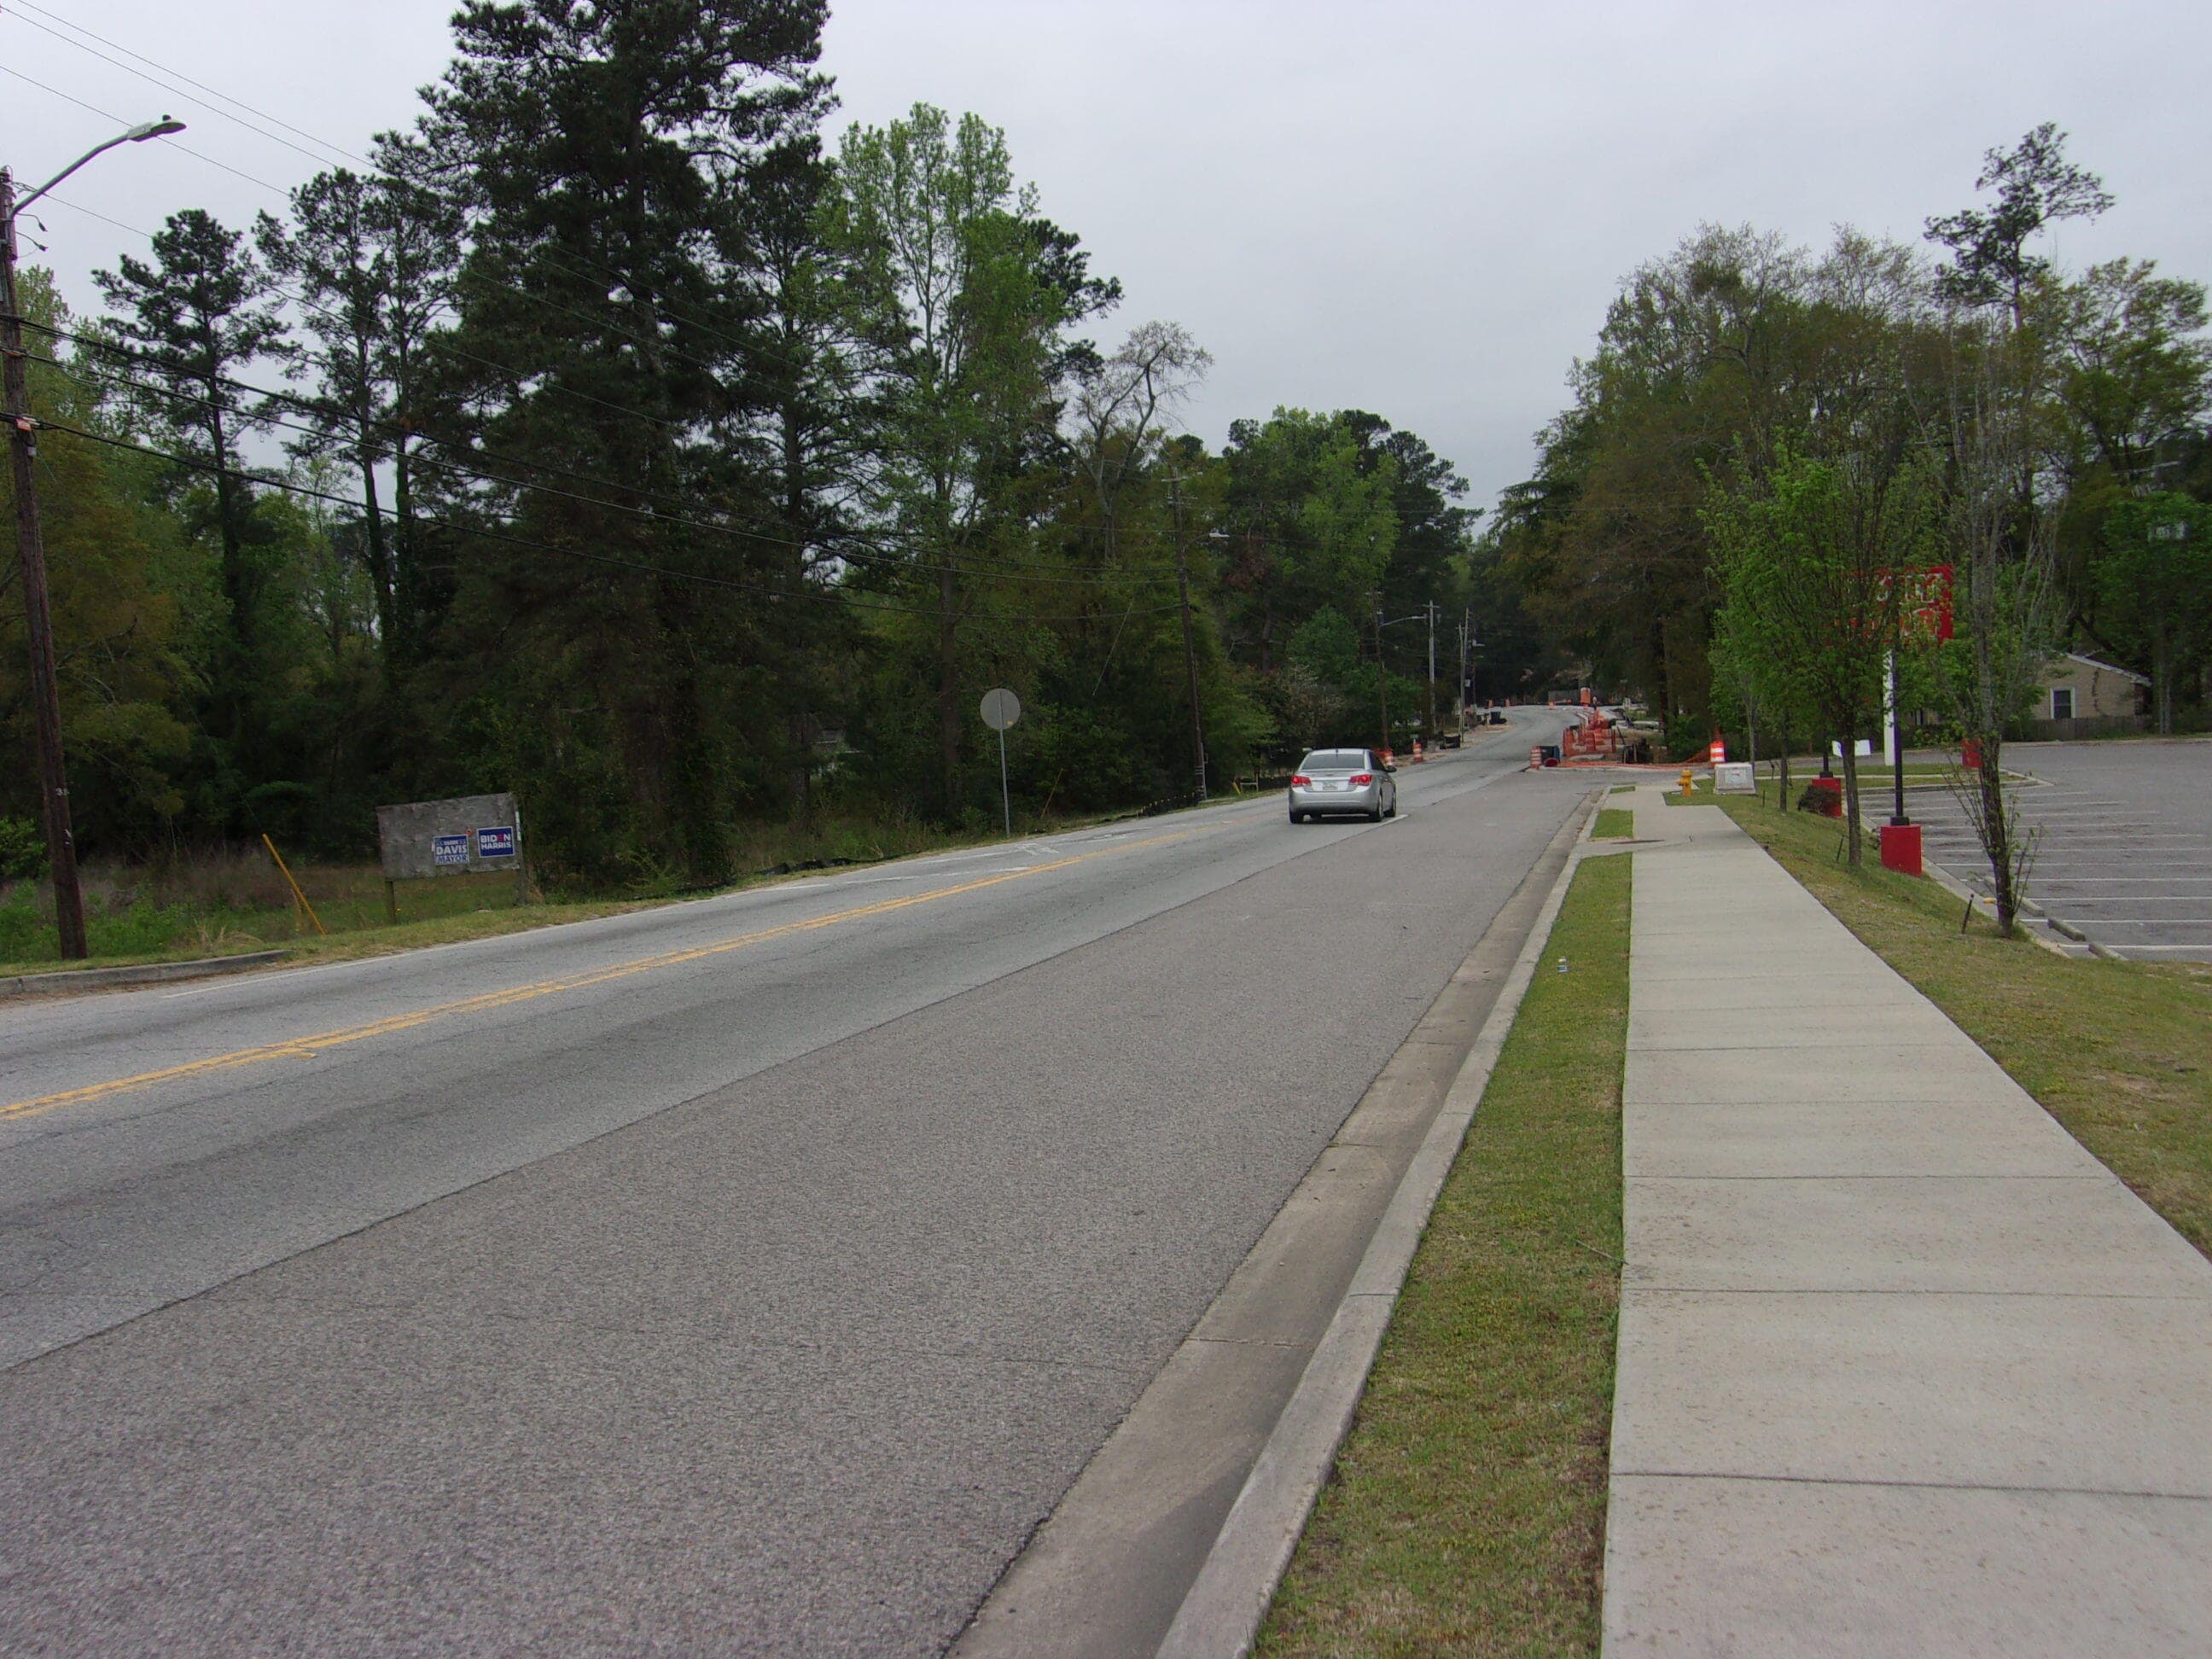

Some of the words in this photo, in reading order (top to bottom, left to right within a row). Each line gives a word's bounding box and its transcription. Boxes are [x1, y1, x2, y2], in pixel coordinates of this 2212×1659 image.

[480, 834, 511, 842] BIDEN
[436, 845, 467, 855] DAVIS
[437, 854, 467, 864] MAYOR
